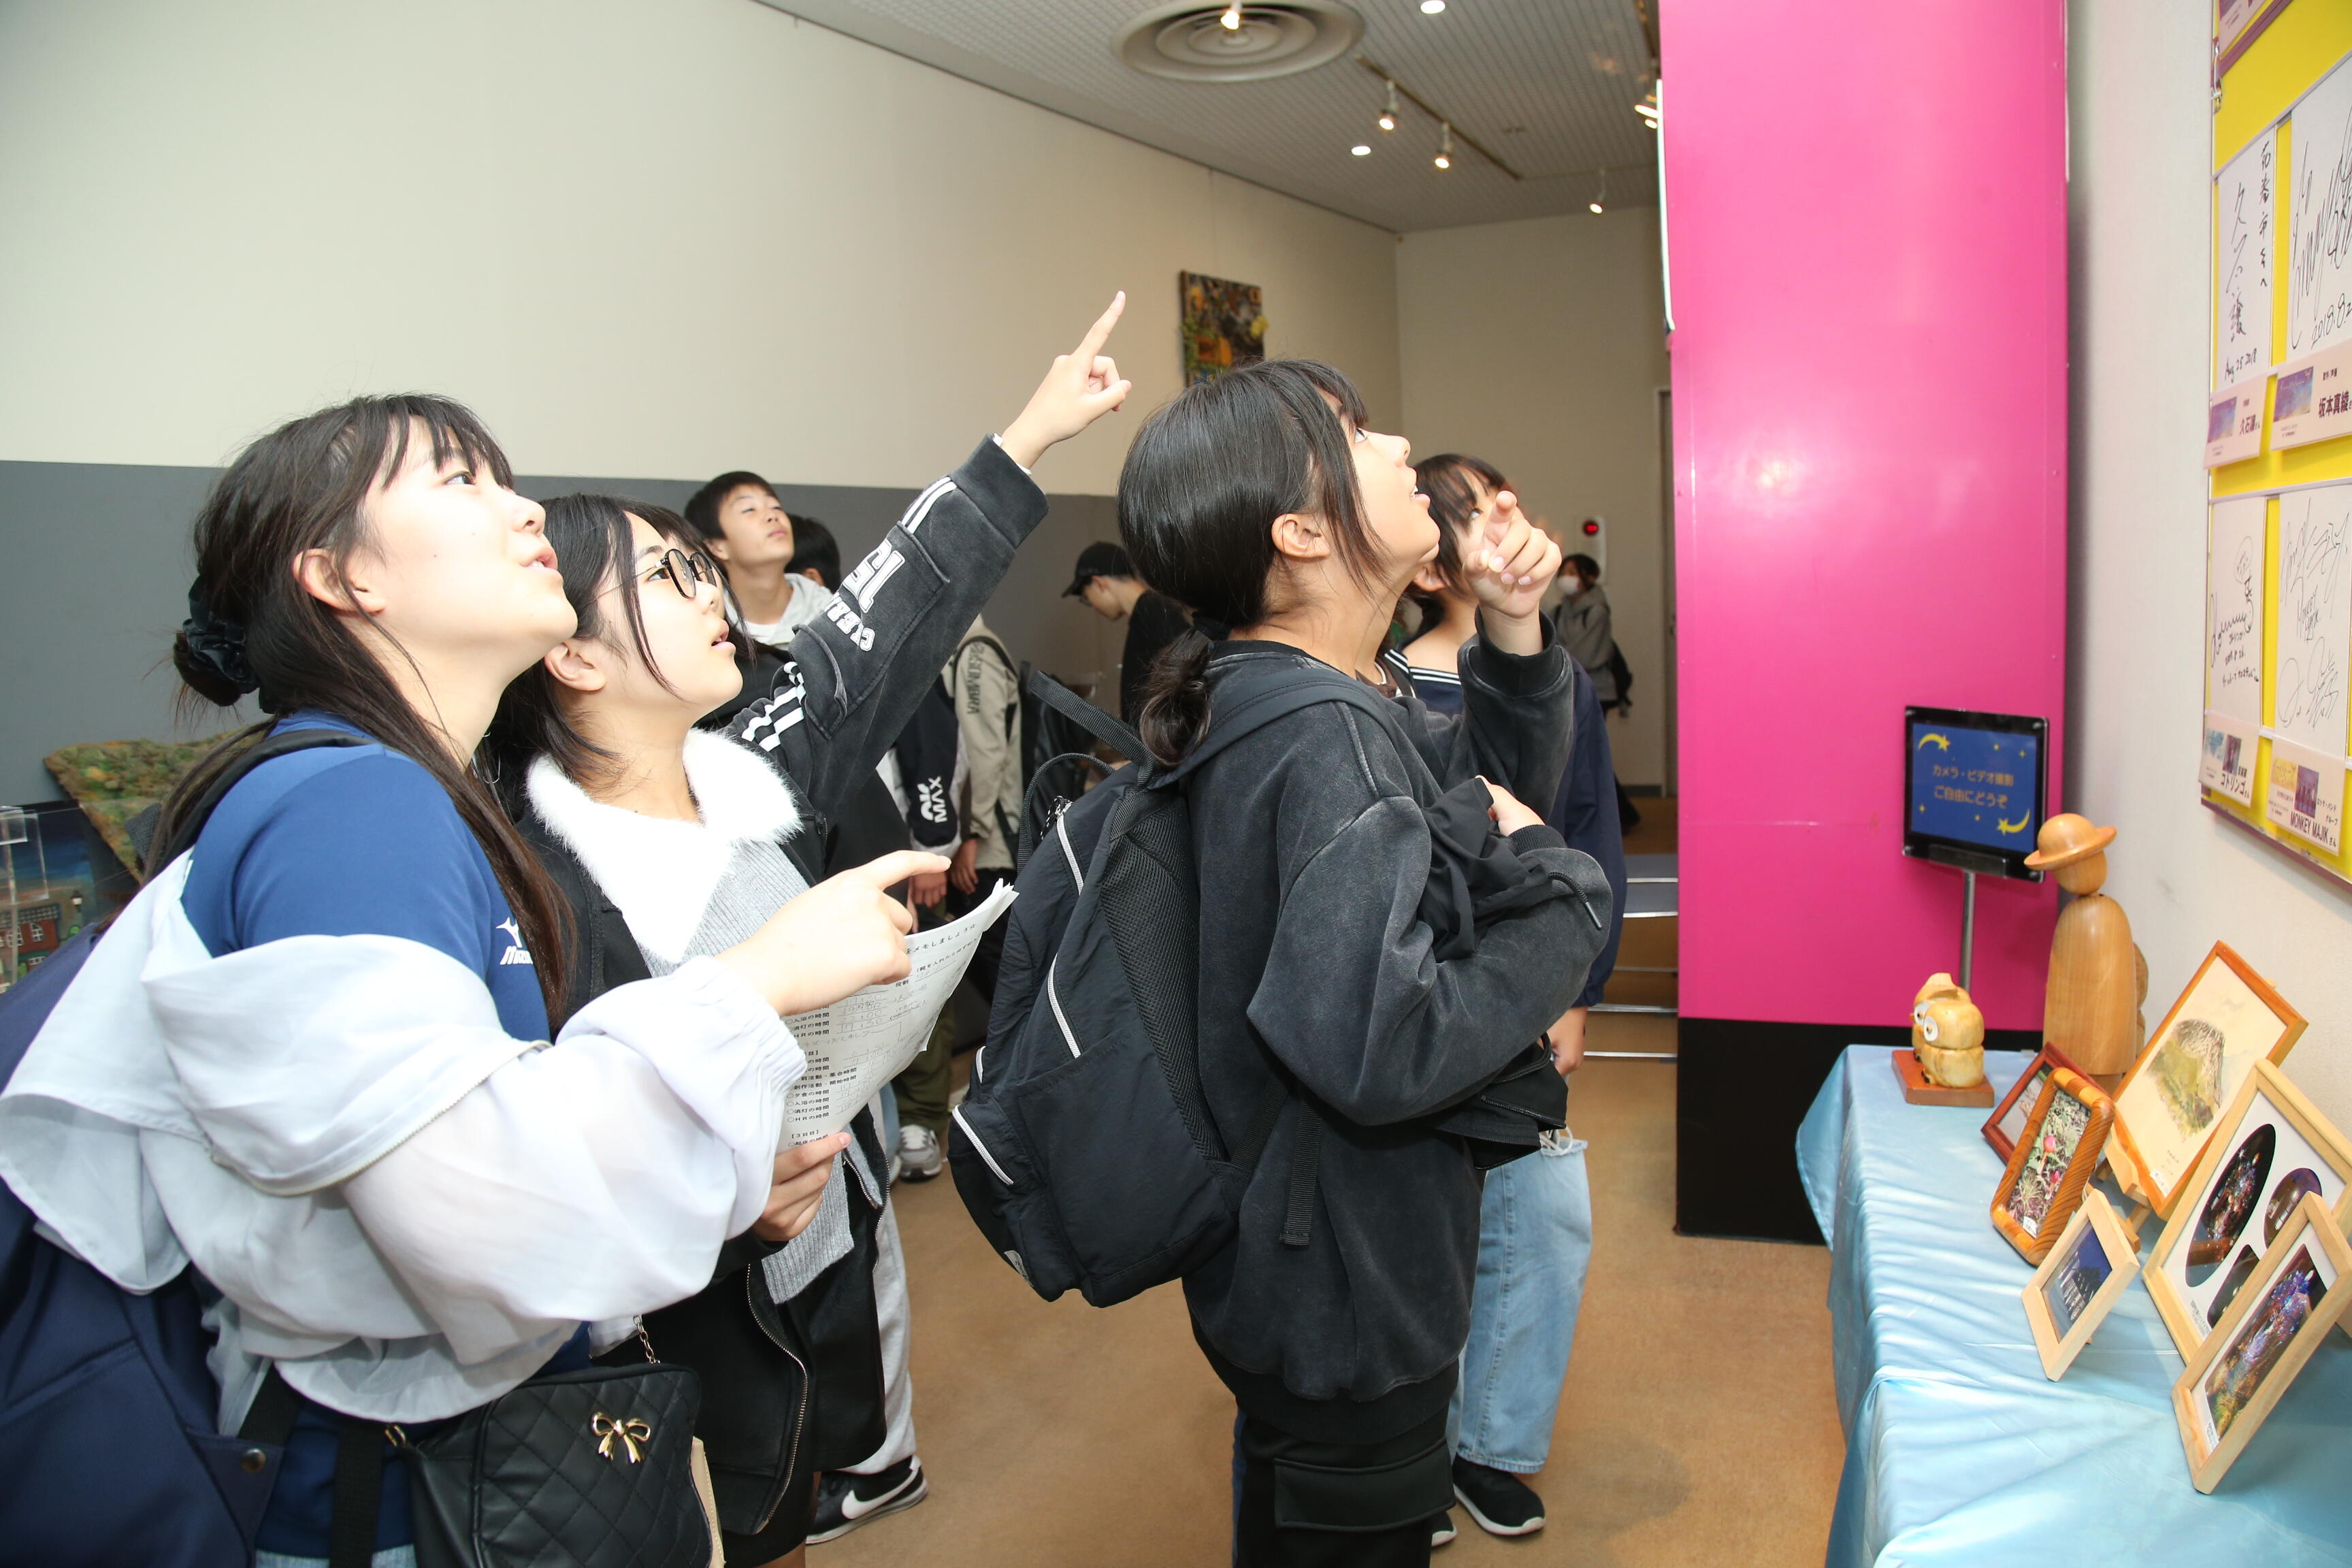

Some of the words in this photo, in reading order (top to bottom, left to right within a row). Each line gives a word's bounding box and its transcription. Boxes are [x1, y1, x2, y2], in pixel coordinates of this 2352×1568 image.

[1934, 785, 2009, 809] ご自由にどうぞ
[2290, 811, 2311, 834] MONKEY
[2312, 822, 2329, 845] MAJIK
